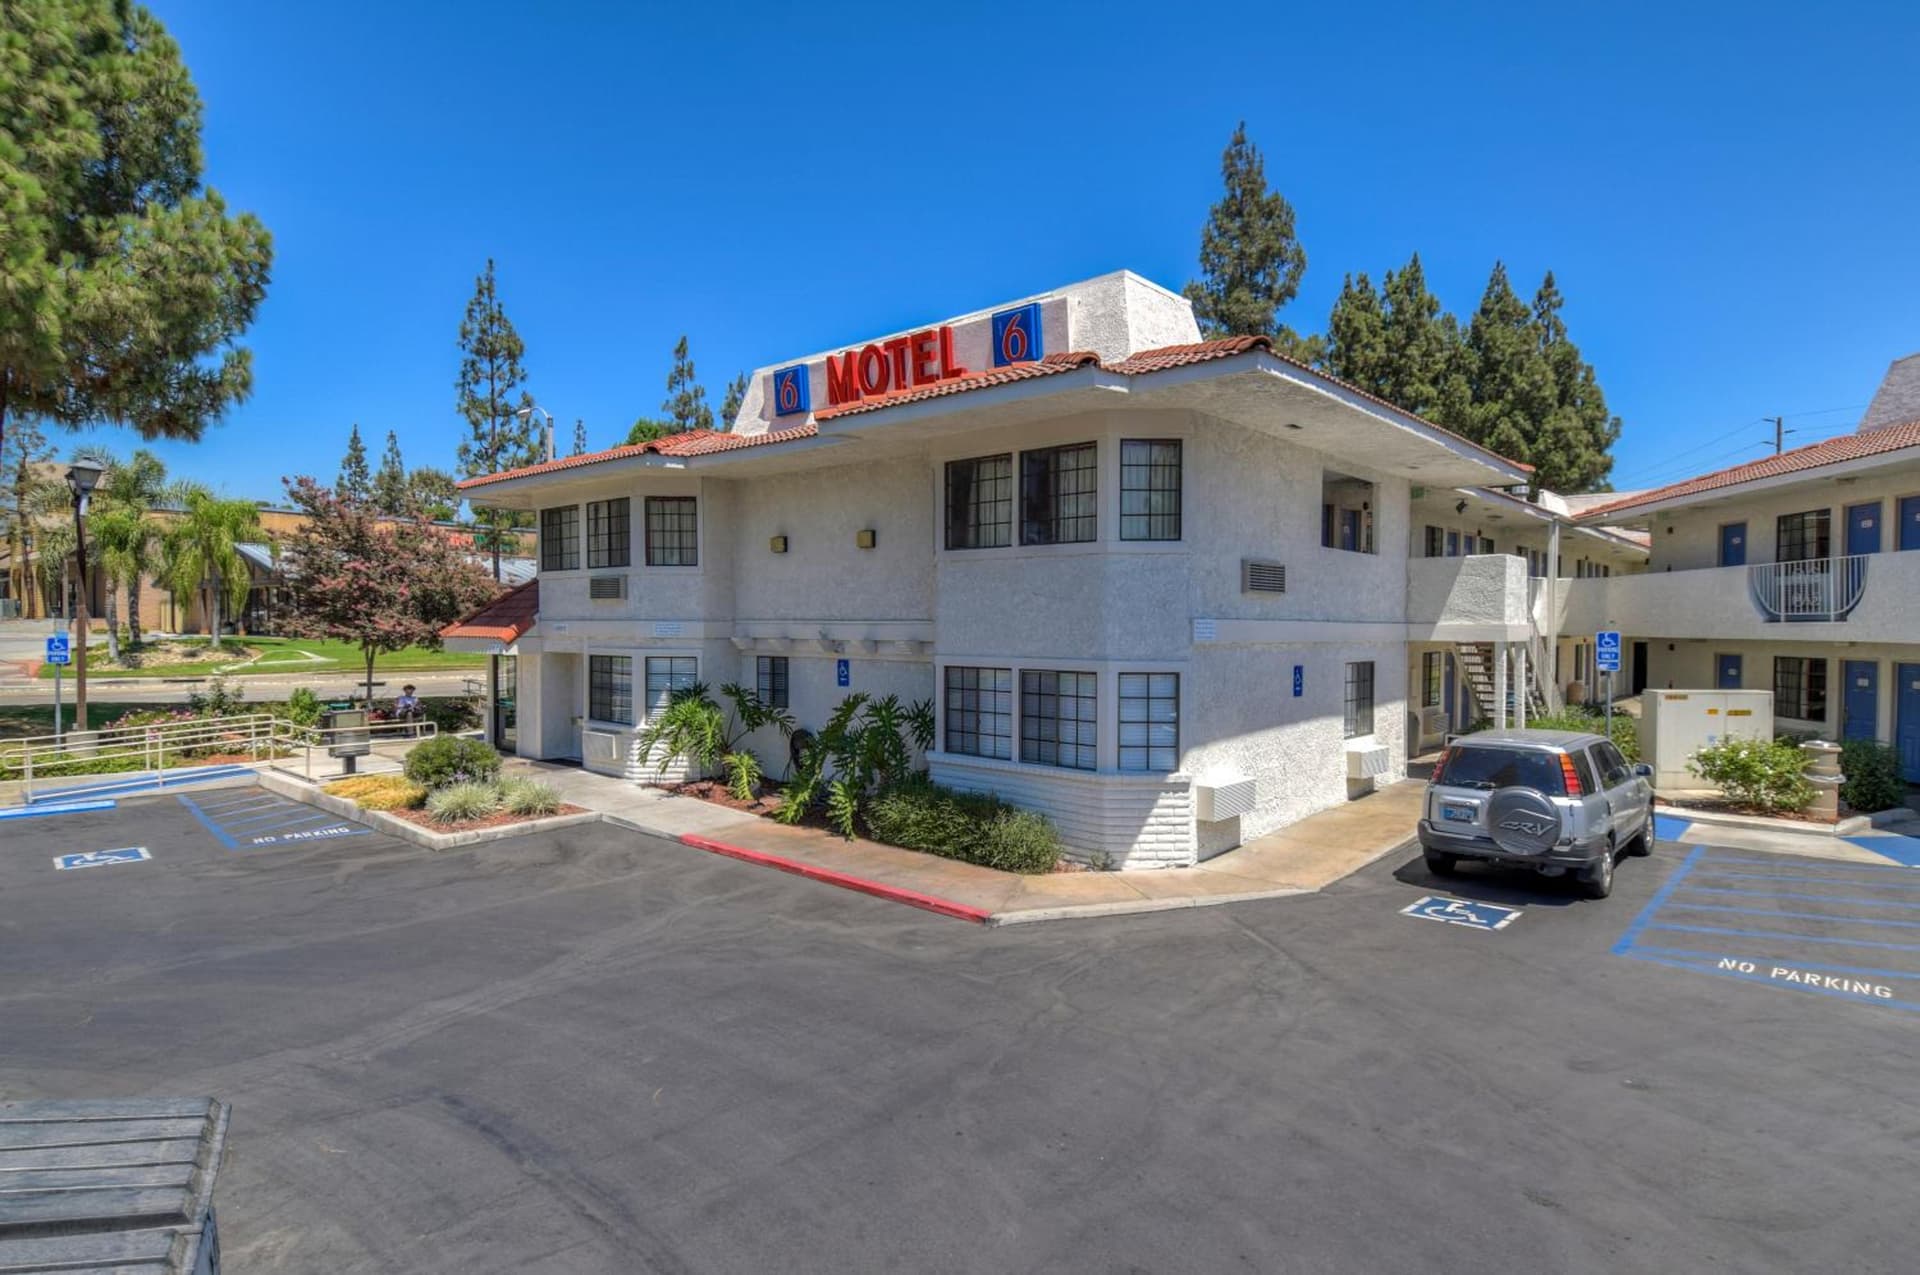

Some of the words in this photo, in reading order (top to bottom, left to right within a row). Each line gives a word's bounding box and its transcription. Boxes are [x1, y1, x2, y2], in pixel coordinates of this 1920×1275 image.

[781, 373, 798, 410] 6
[826, 326, 968, 405] MOTEL
[1002, 313, 1027, 361] 6
[283, 827, 350, 840] PARKING
[1717, 958, 1756, 973] NO
[1770, 967, 1893, 999] PARKING
